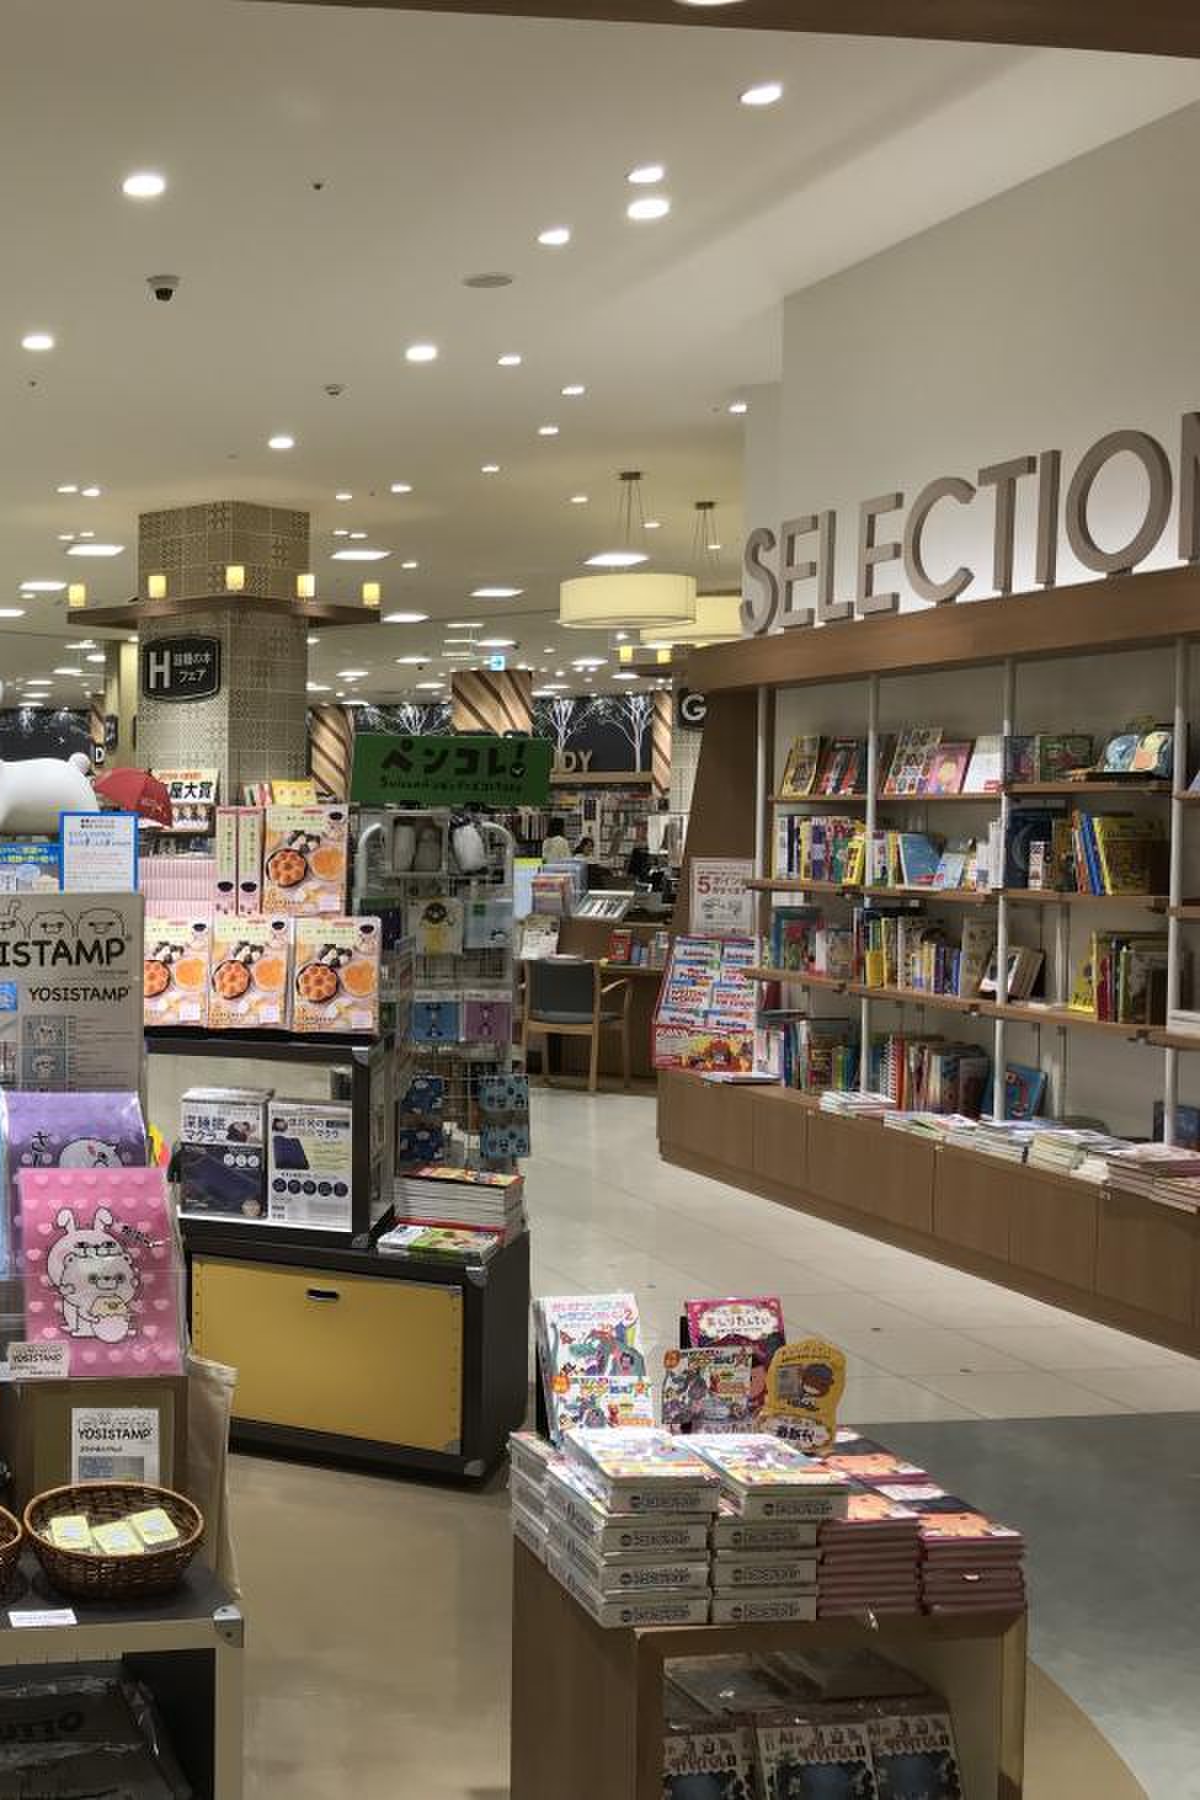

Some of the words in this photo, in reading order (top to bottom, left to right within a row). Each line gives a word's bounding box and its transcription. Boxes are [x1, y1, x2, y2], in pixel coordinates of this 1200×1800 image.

[149, 649, 171, 689] H
[682, 693, 707, 721] G
[165, 781, 213, 799] 屋大賞
[28, 985, 130, 1002] YOSISTAMP
[78, 1427, 153, 1441] YOSISTAMP
